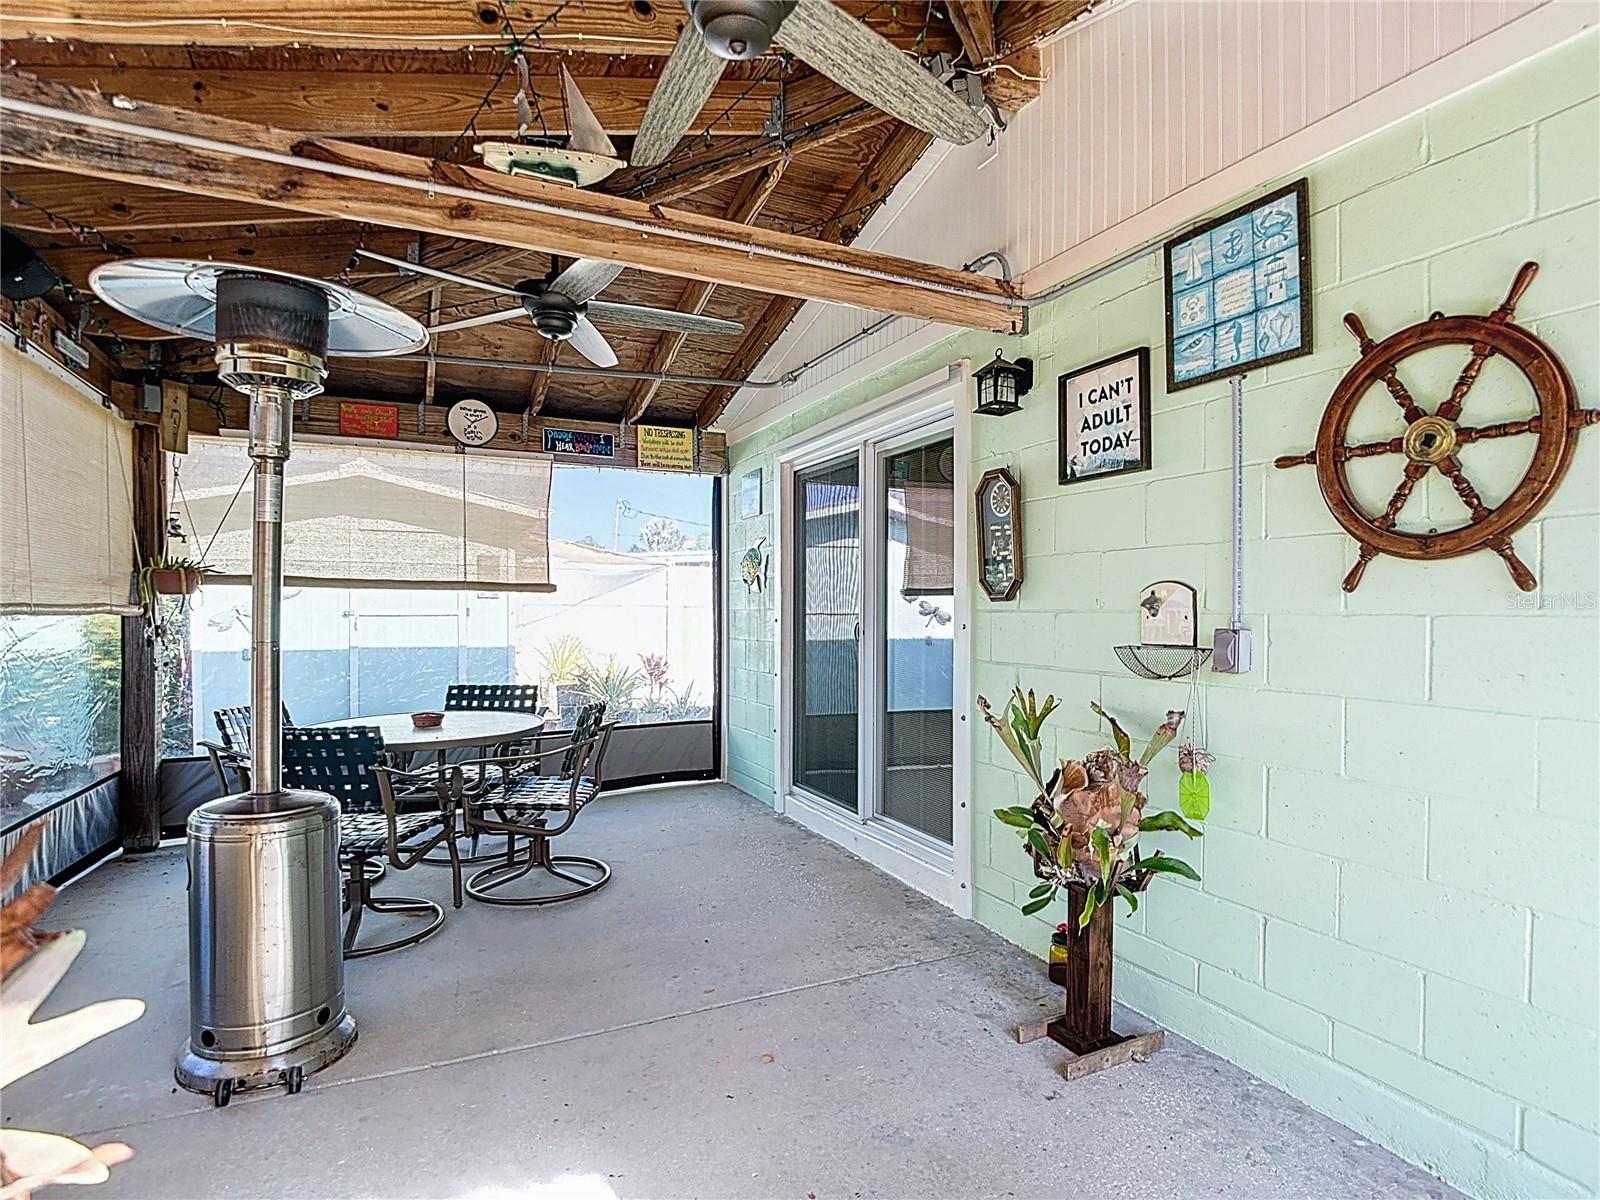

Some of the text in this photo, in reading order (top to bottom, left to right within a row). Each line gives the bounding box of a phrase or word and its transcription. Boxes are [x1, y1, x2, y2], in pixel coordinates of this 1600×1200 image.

[1079, 376, 1134, 409] I CAN'T
[1080, 404, 1132, 433] ADULT
[555, 440, 576, 453] HEAR
[644, 428, 686, 439] NO TRESPASSING
[1080, 430, 1133, 457] TODAY
